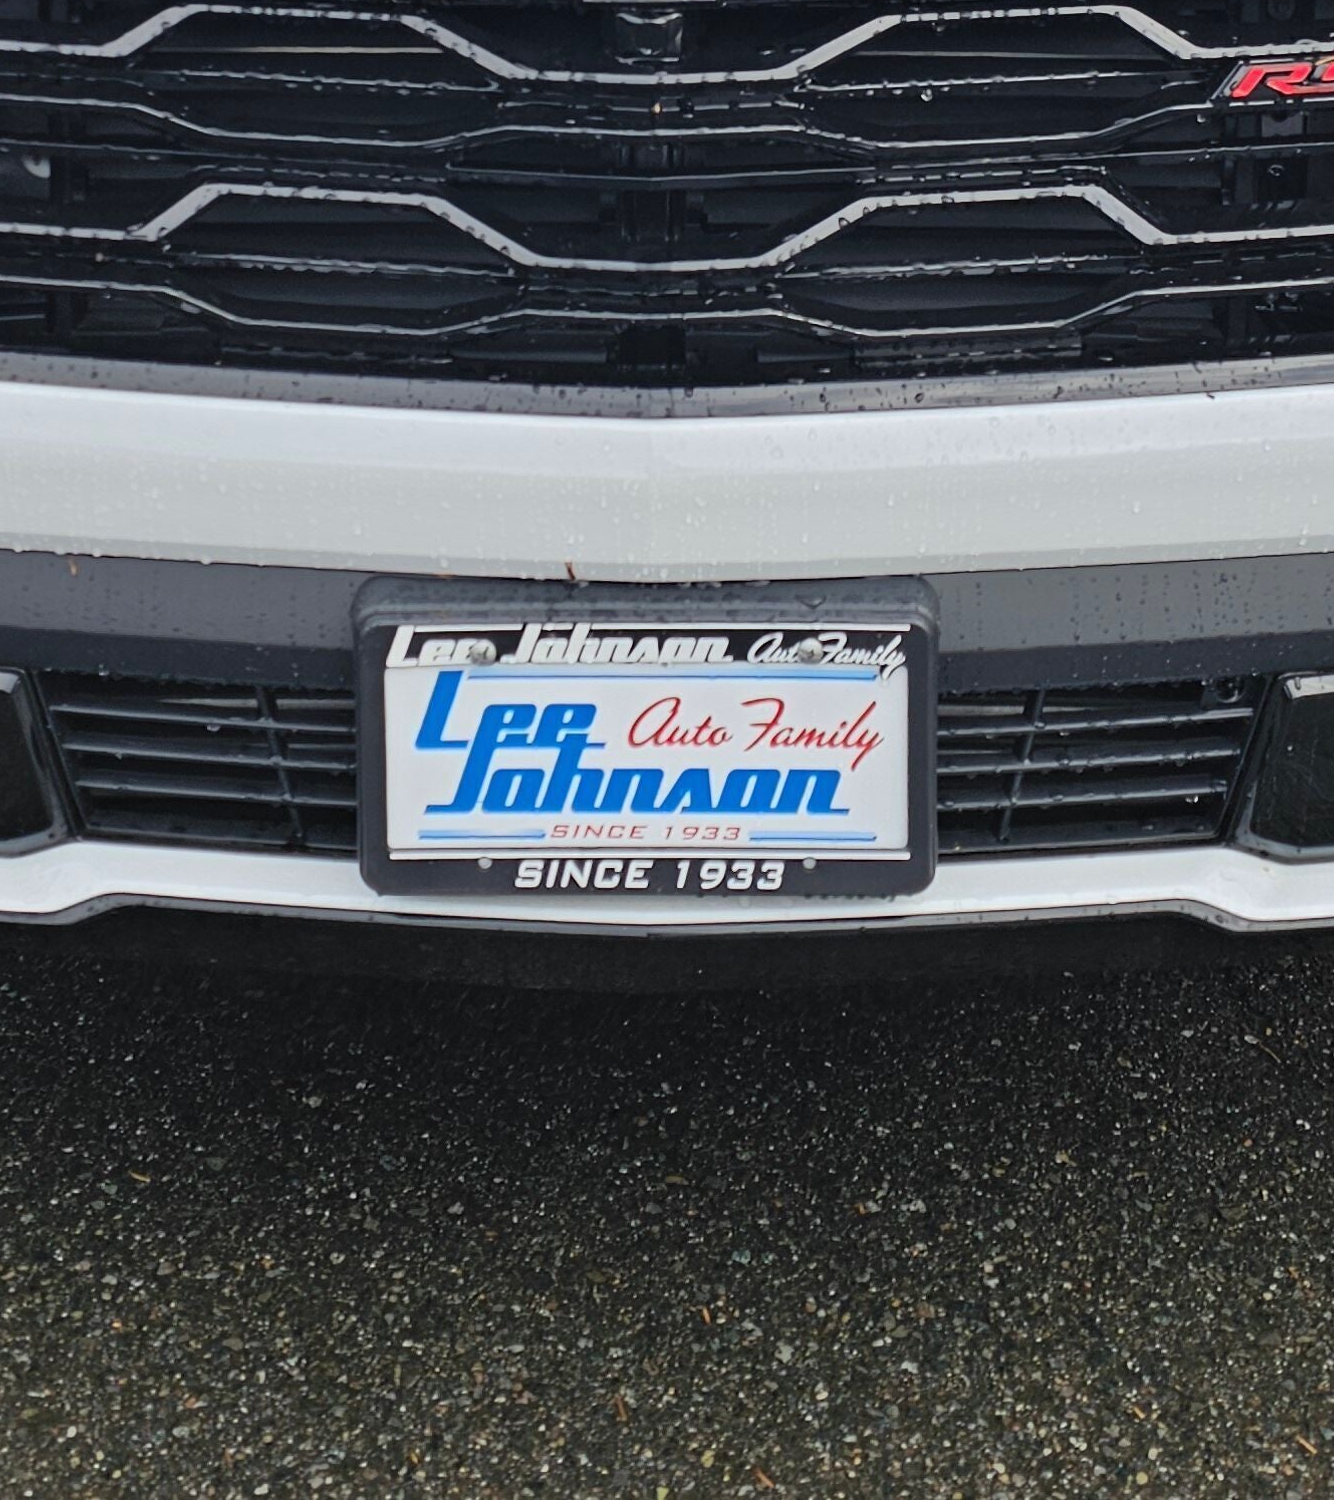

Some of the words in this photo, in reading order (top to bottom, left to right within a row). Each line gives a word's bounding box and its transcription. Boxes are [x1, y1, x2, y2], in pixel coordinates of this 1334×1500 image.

[499, 622, 734, 666] Johnson
[747, 632, 823, 664] Aut
[818, 633, 907, 681] Family
[415, 670, 606, 750] Lee
[628, 697, 733, 749] Auto
[741, 697, 884, 772] Family
[423, 736, 850, 816] Johnson
[549, 824, 648, 840] SINCE
[664, 825, 743, 842] 1933
[513, 859, 655, 890] SINCE
[674, 859, 786, 891] 1933
